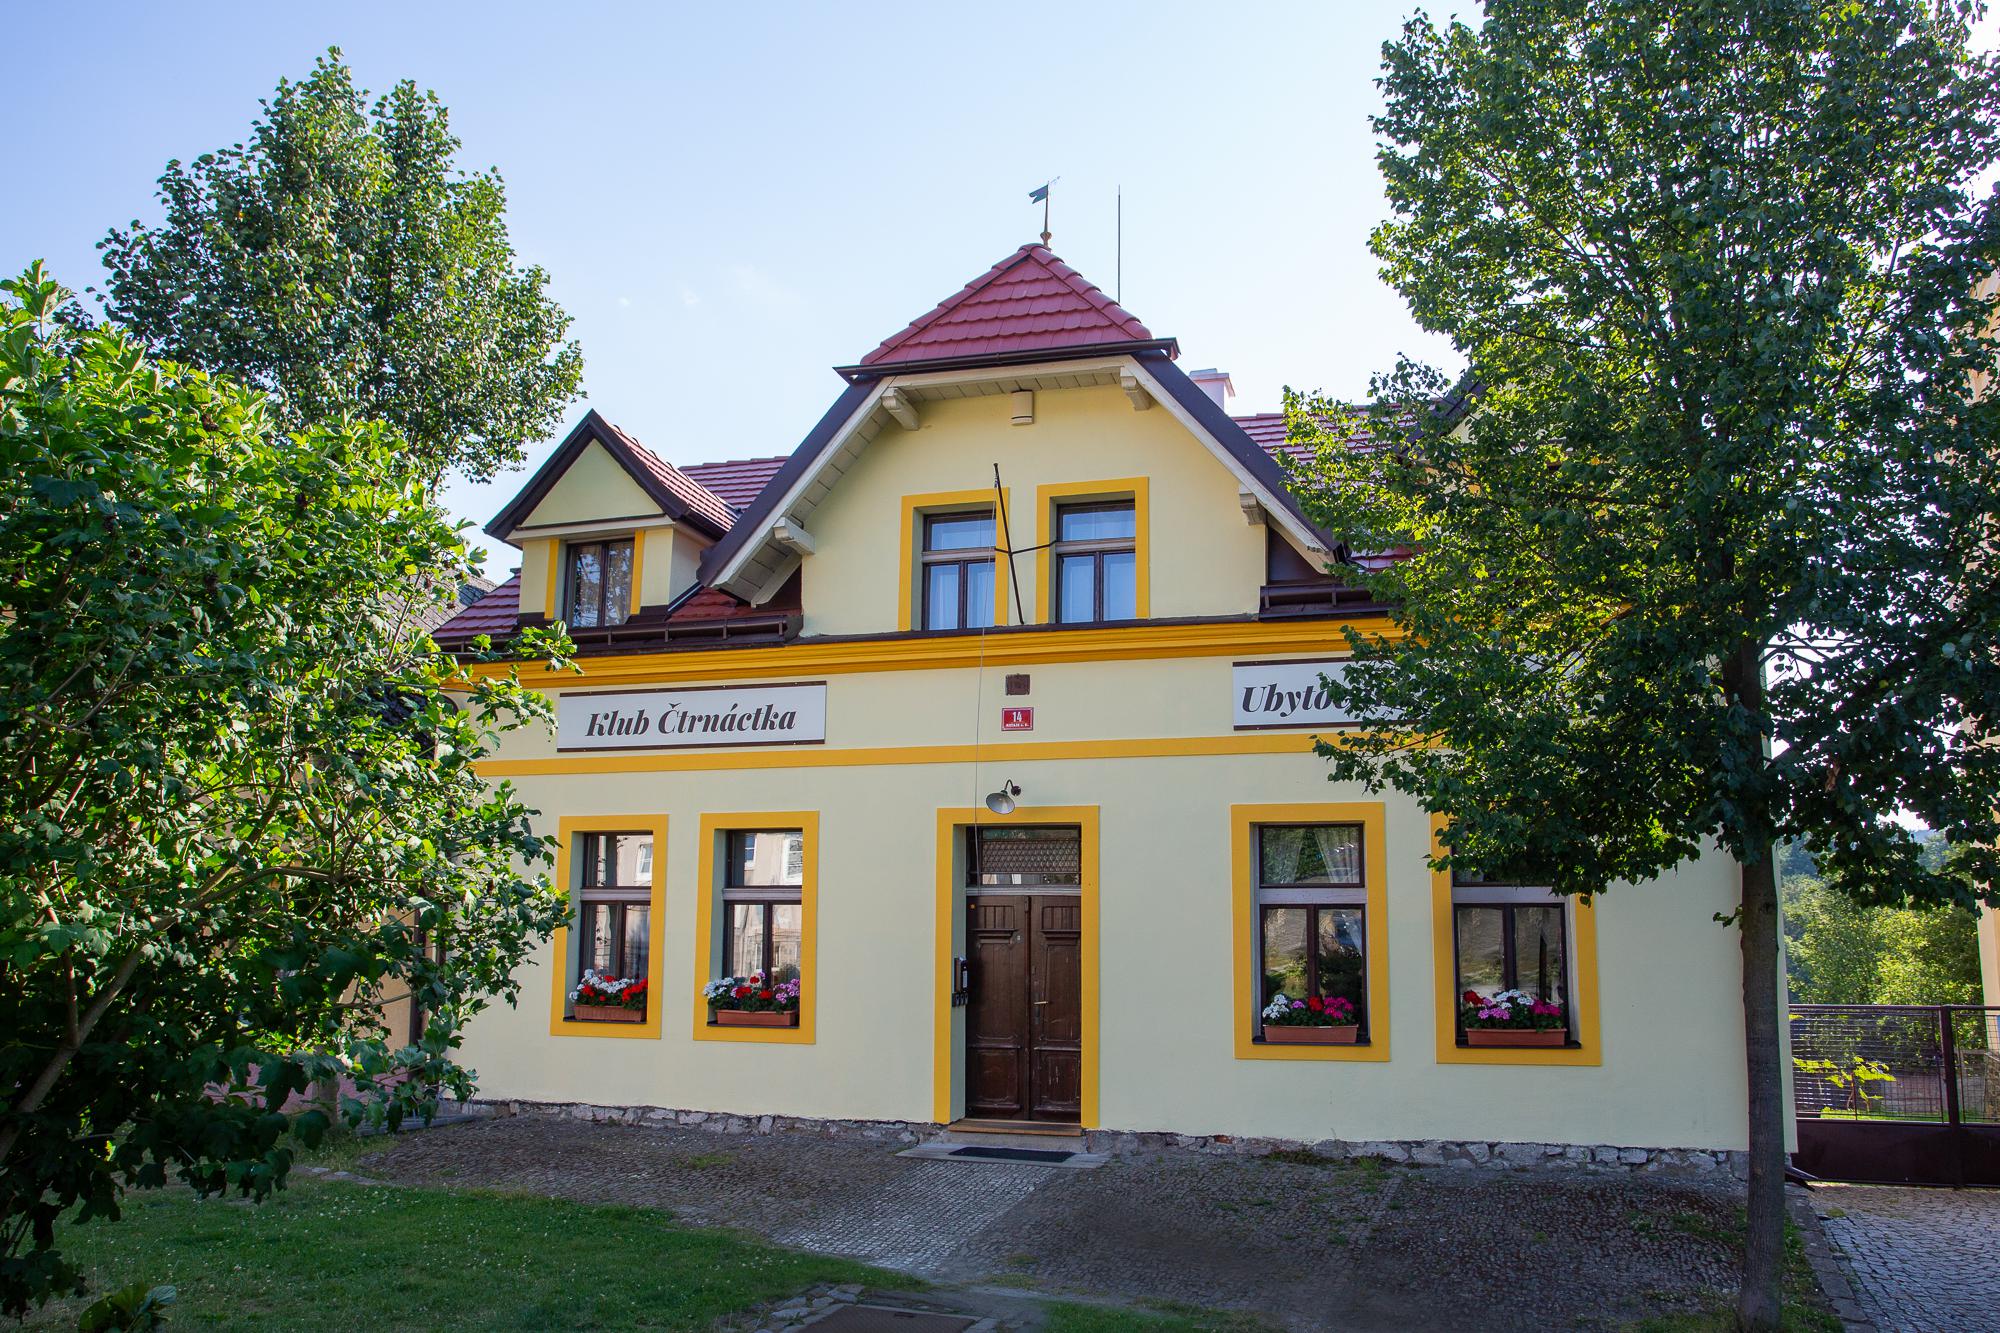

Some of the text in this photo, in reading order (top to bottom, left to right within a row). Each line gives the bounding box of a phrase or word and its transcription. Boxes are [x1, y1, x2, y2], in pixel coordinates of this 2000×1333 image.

[585, 702, 797, 737] Klub Čtrnáctka
[1012, 711, 1022, 722] 14
